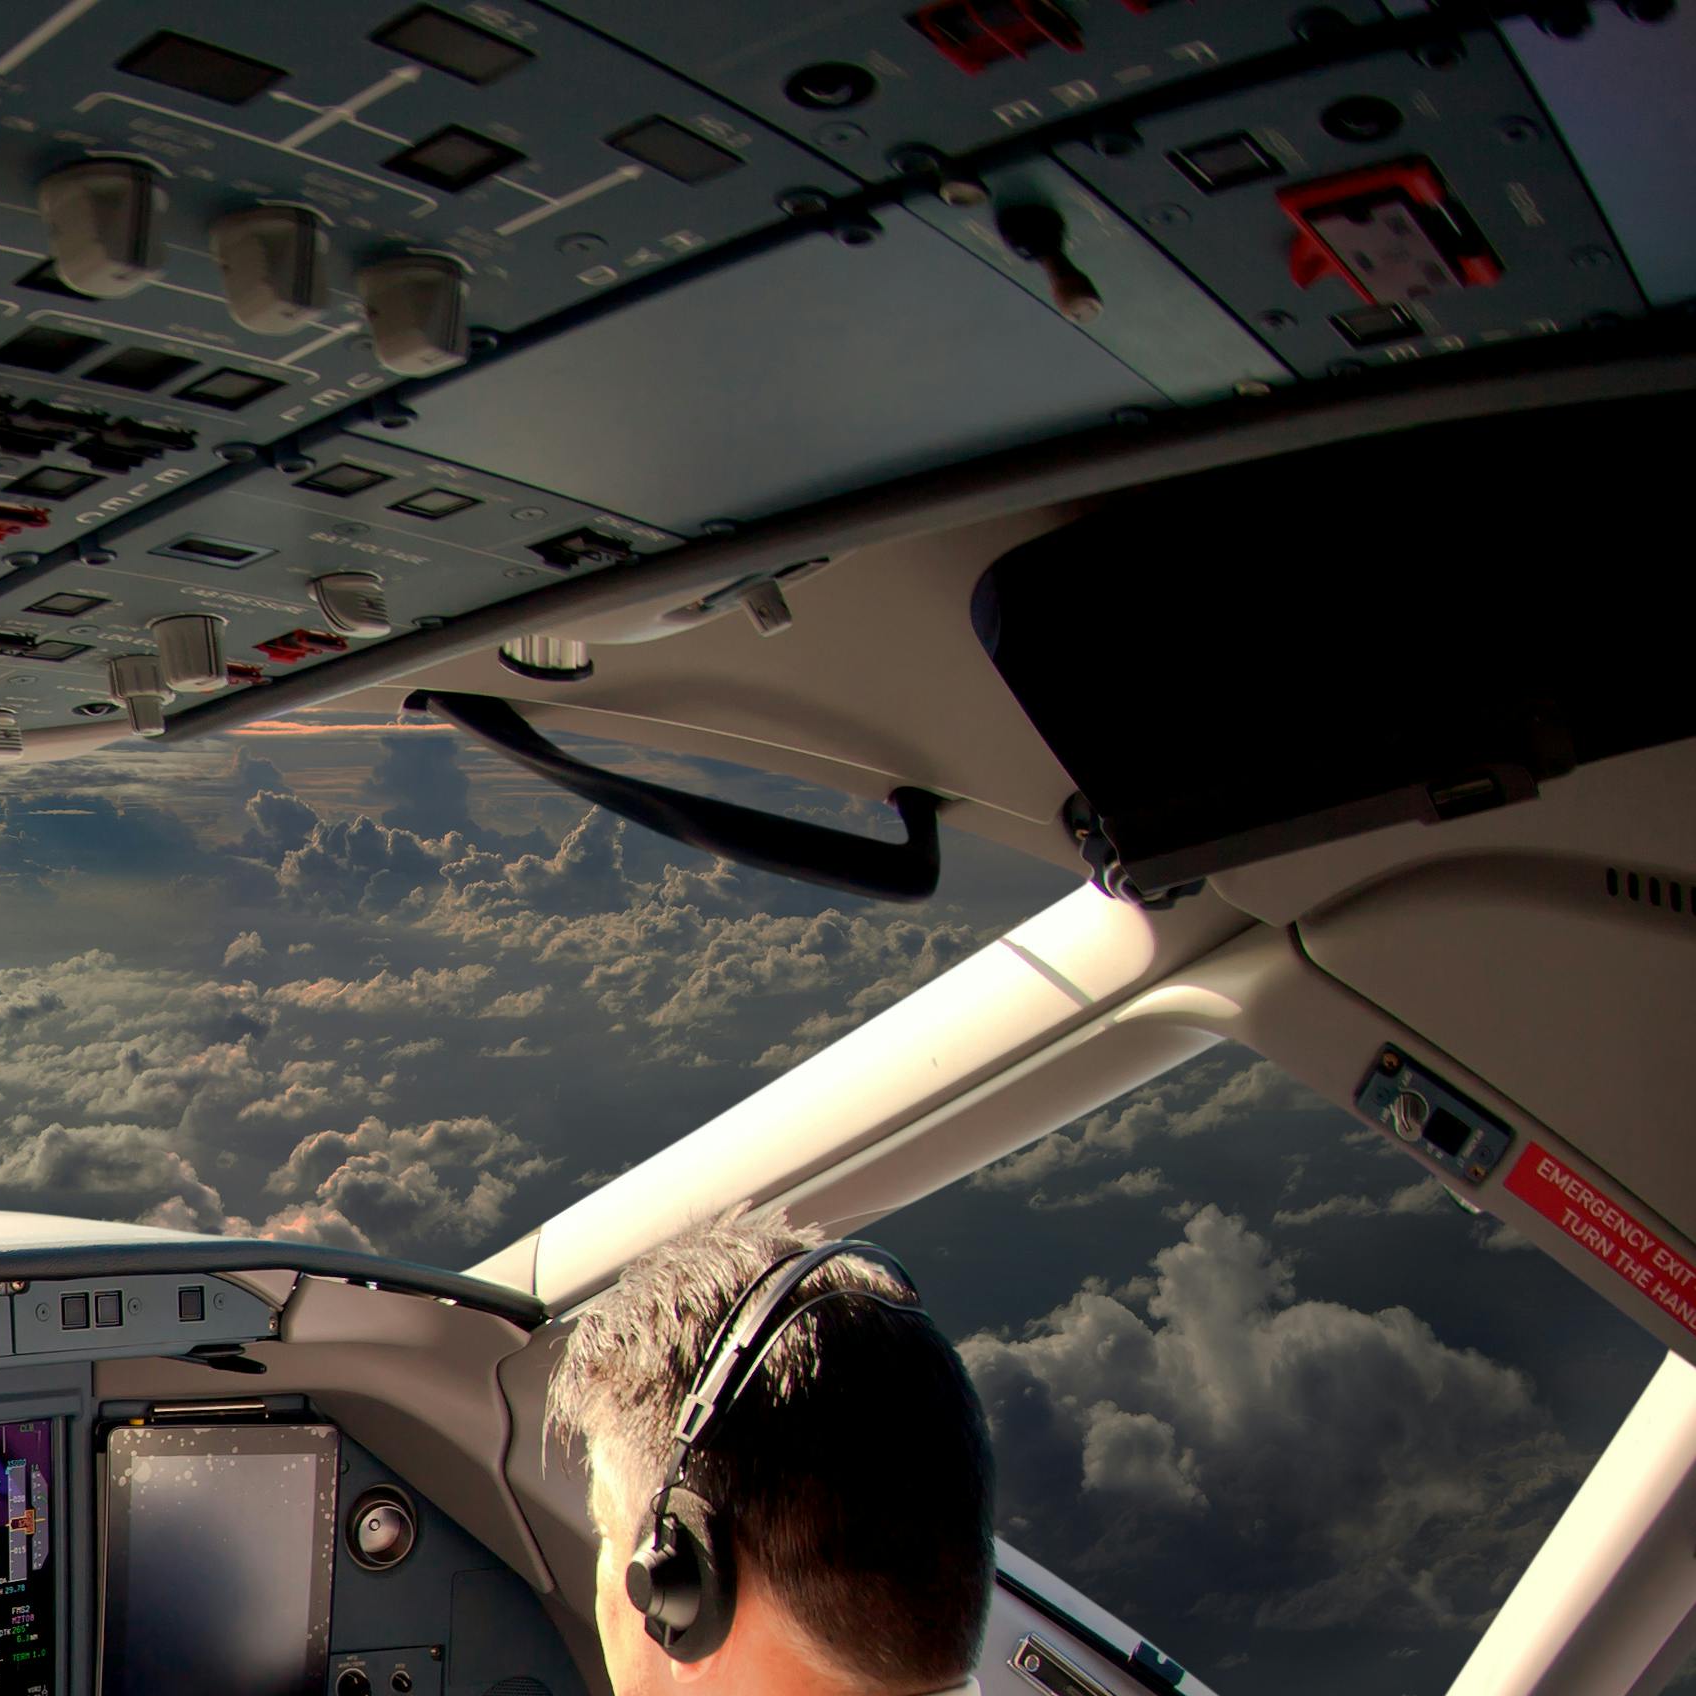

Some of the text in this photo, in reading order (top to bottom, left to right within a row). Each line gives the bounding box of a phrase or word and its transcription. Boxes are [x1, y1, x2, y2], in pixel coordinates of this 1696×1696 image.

[1537, 1158, 1696, 1286] EMERGENCY EXIT
[1561, 1208, 1614, 1257] TURN
[1615, 1250, 1654, 1288] THE
